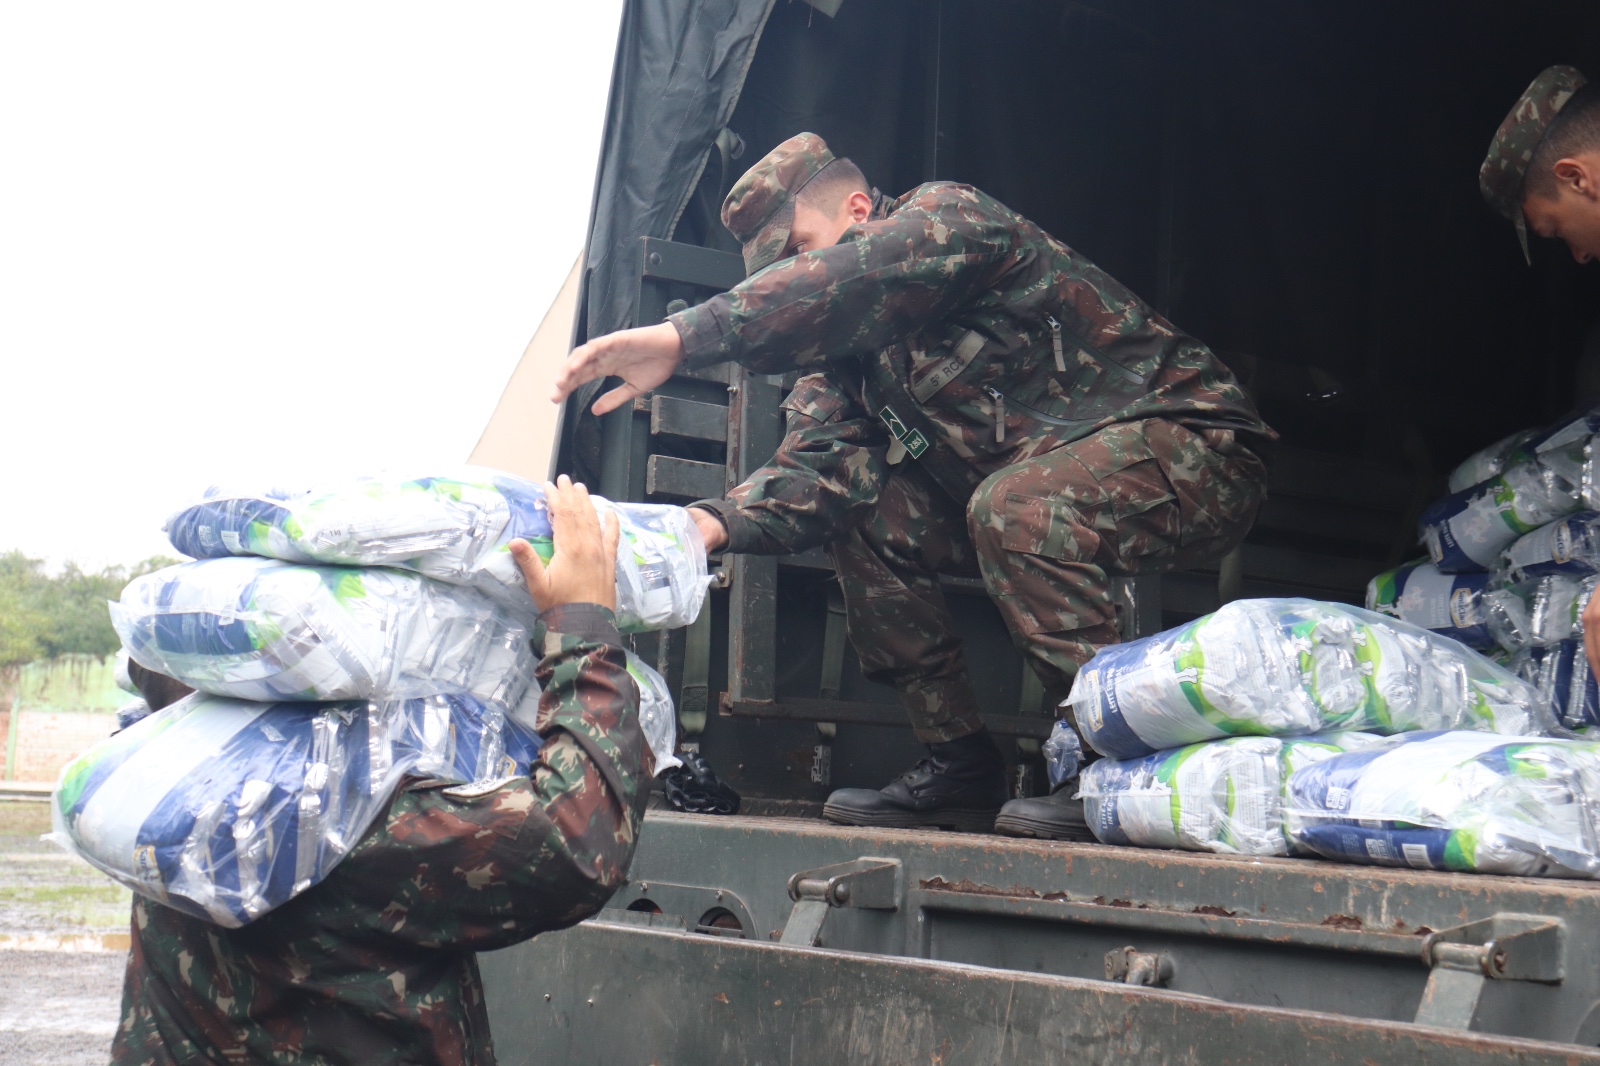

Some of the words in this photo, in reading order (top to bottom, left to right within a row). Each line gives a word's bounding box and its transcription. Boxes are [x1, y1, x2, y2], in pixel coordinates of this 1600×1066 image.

[942, 355, 965, 377] RCC
[1105, 691, 1118, 714] LEITE
[1101, 809, 1109, 829] LEITE
